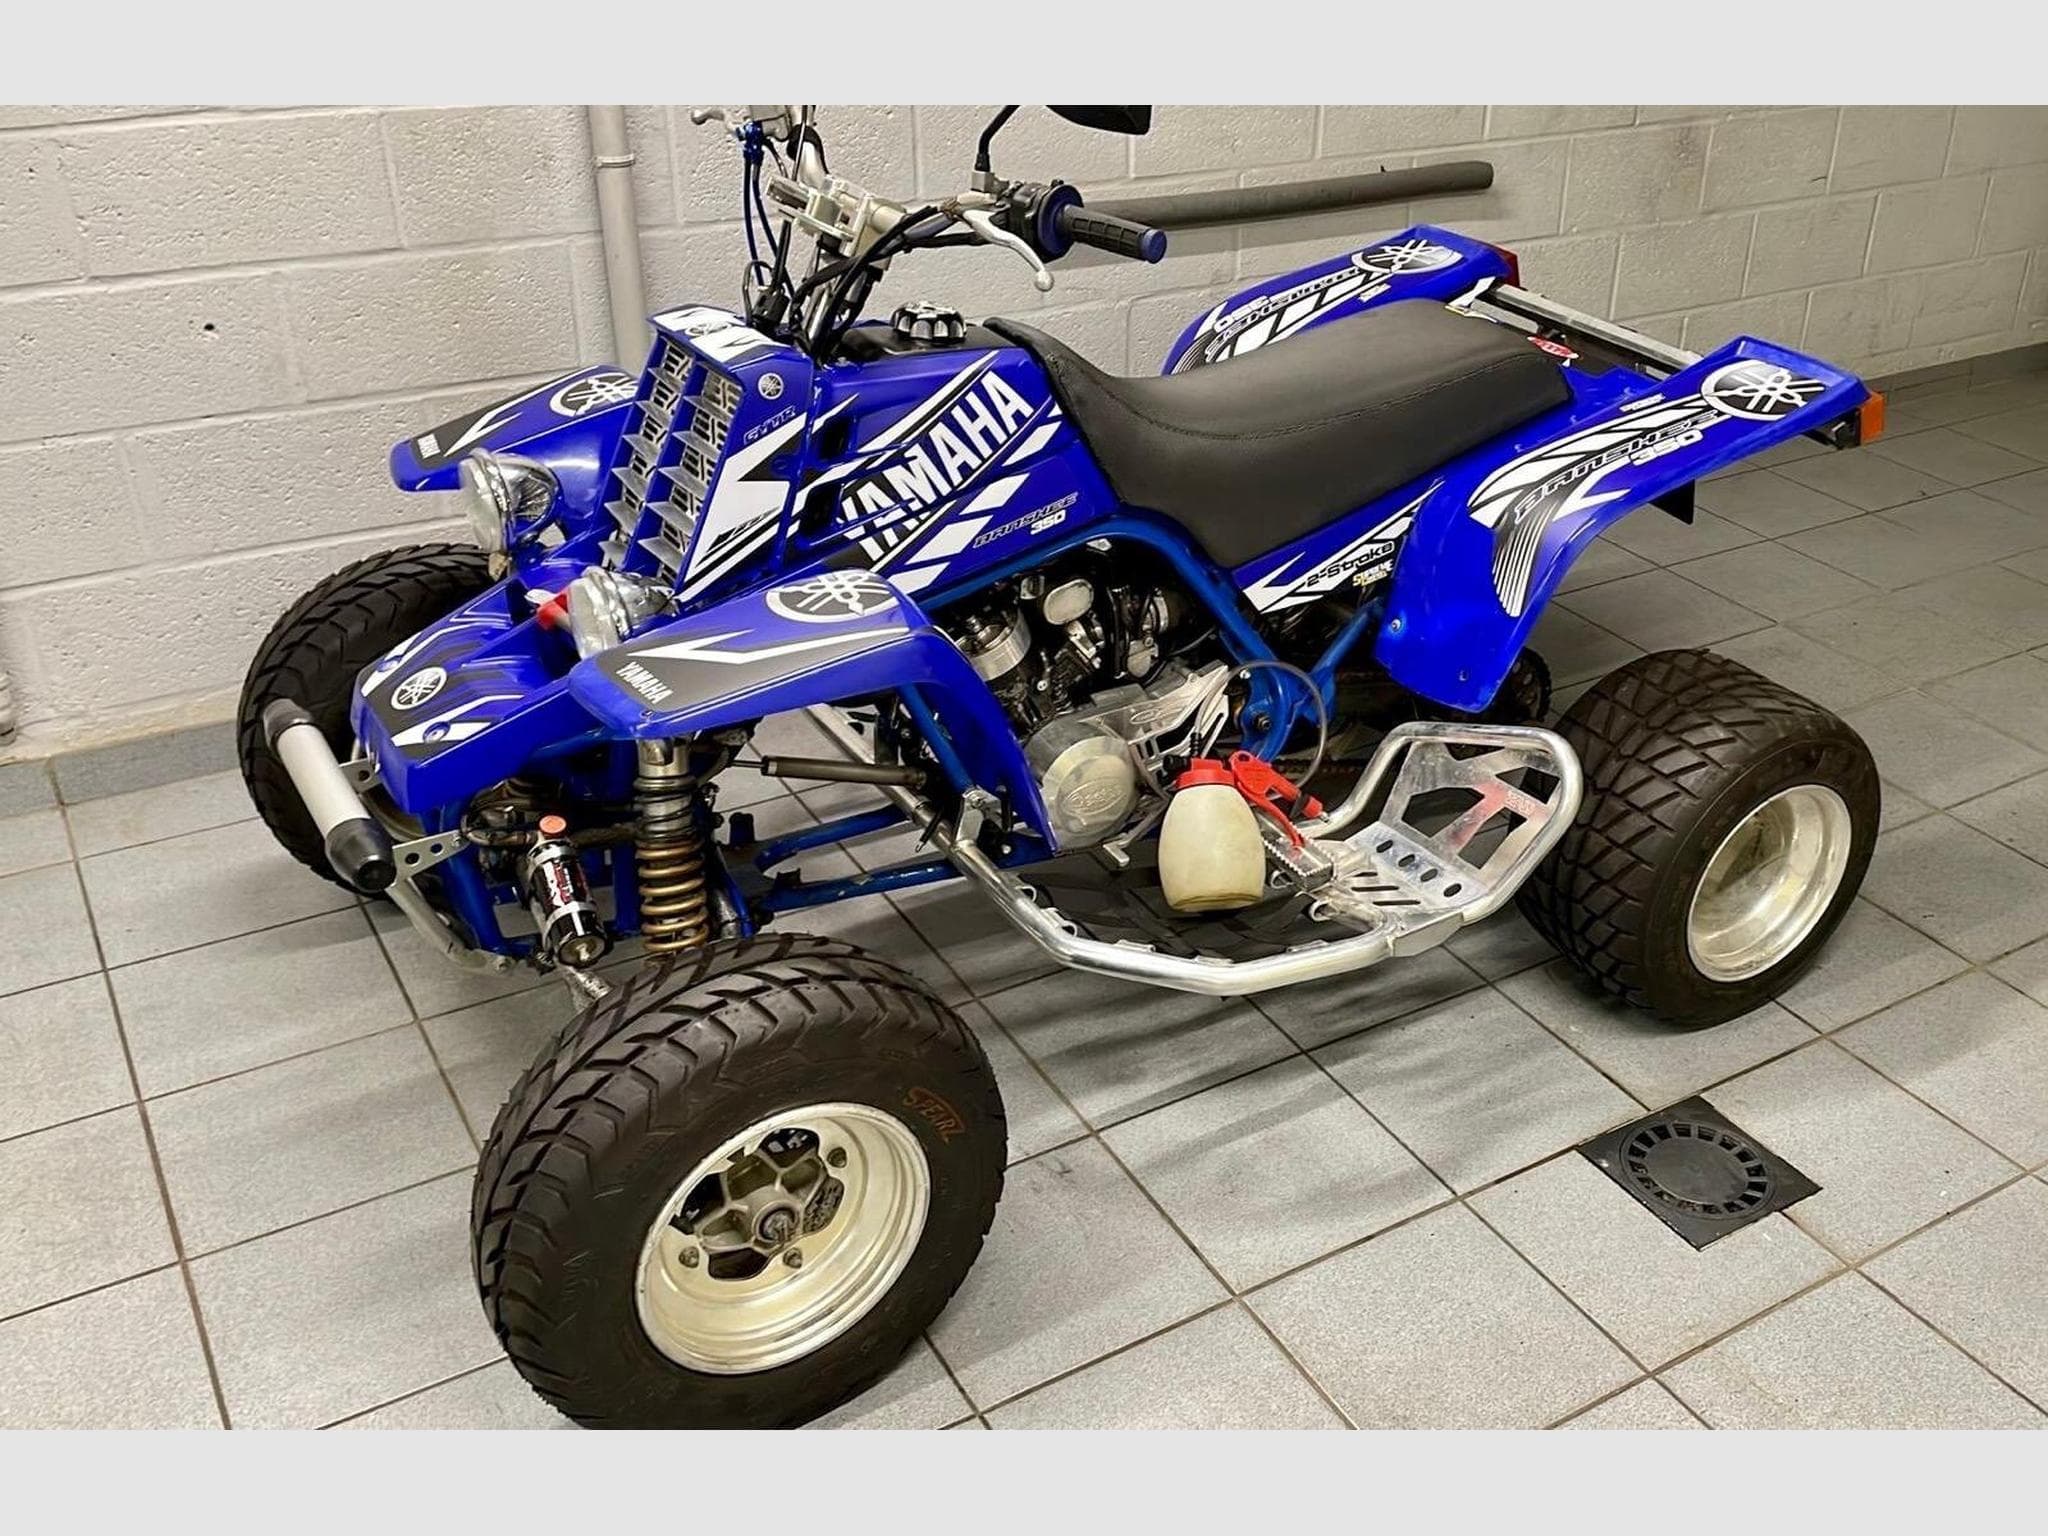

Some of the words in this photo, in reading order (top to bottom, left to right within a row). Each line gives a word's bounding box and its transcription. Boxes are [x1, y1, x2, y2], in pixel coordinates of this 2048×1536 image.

[837, 371, 1034, 562] YAMAHA
[1629, 428, 1704, 466] 350
[1030, 509, 1067, 536] 350
[1306, 542, 1394, 588] 2-Stroke
[615, 661, 674, 704] YAMAHA
